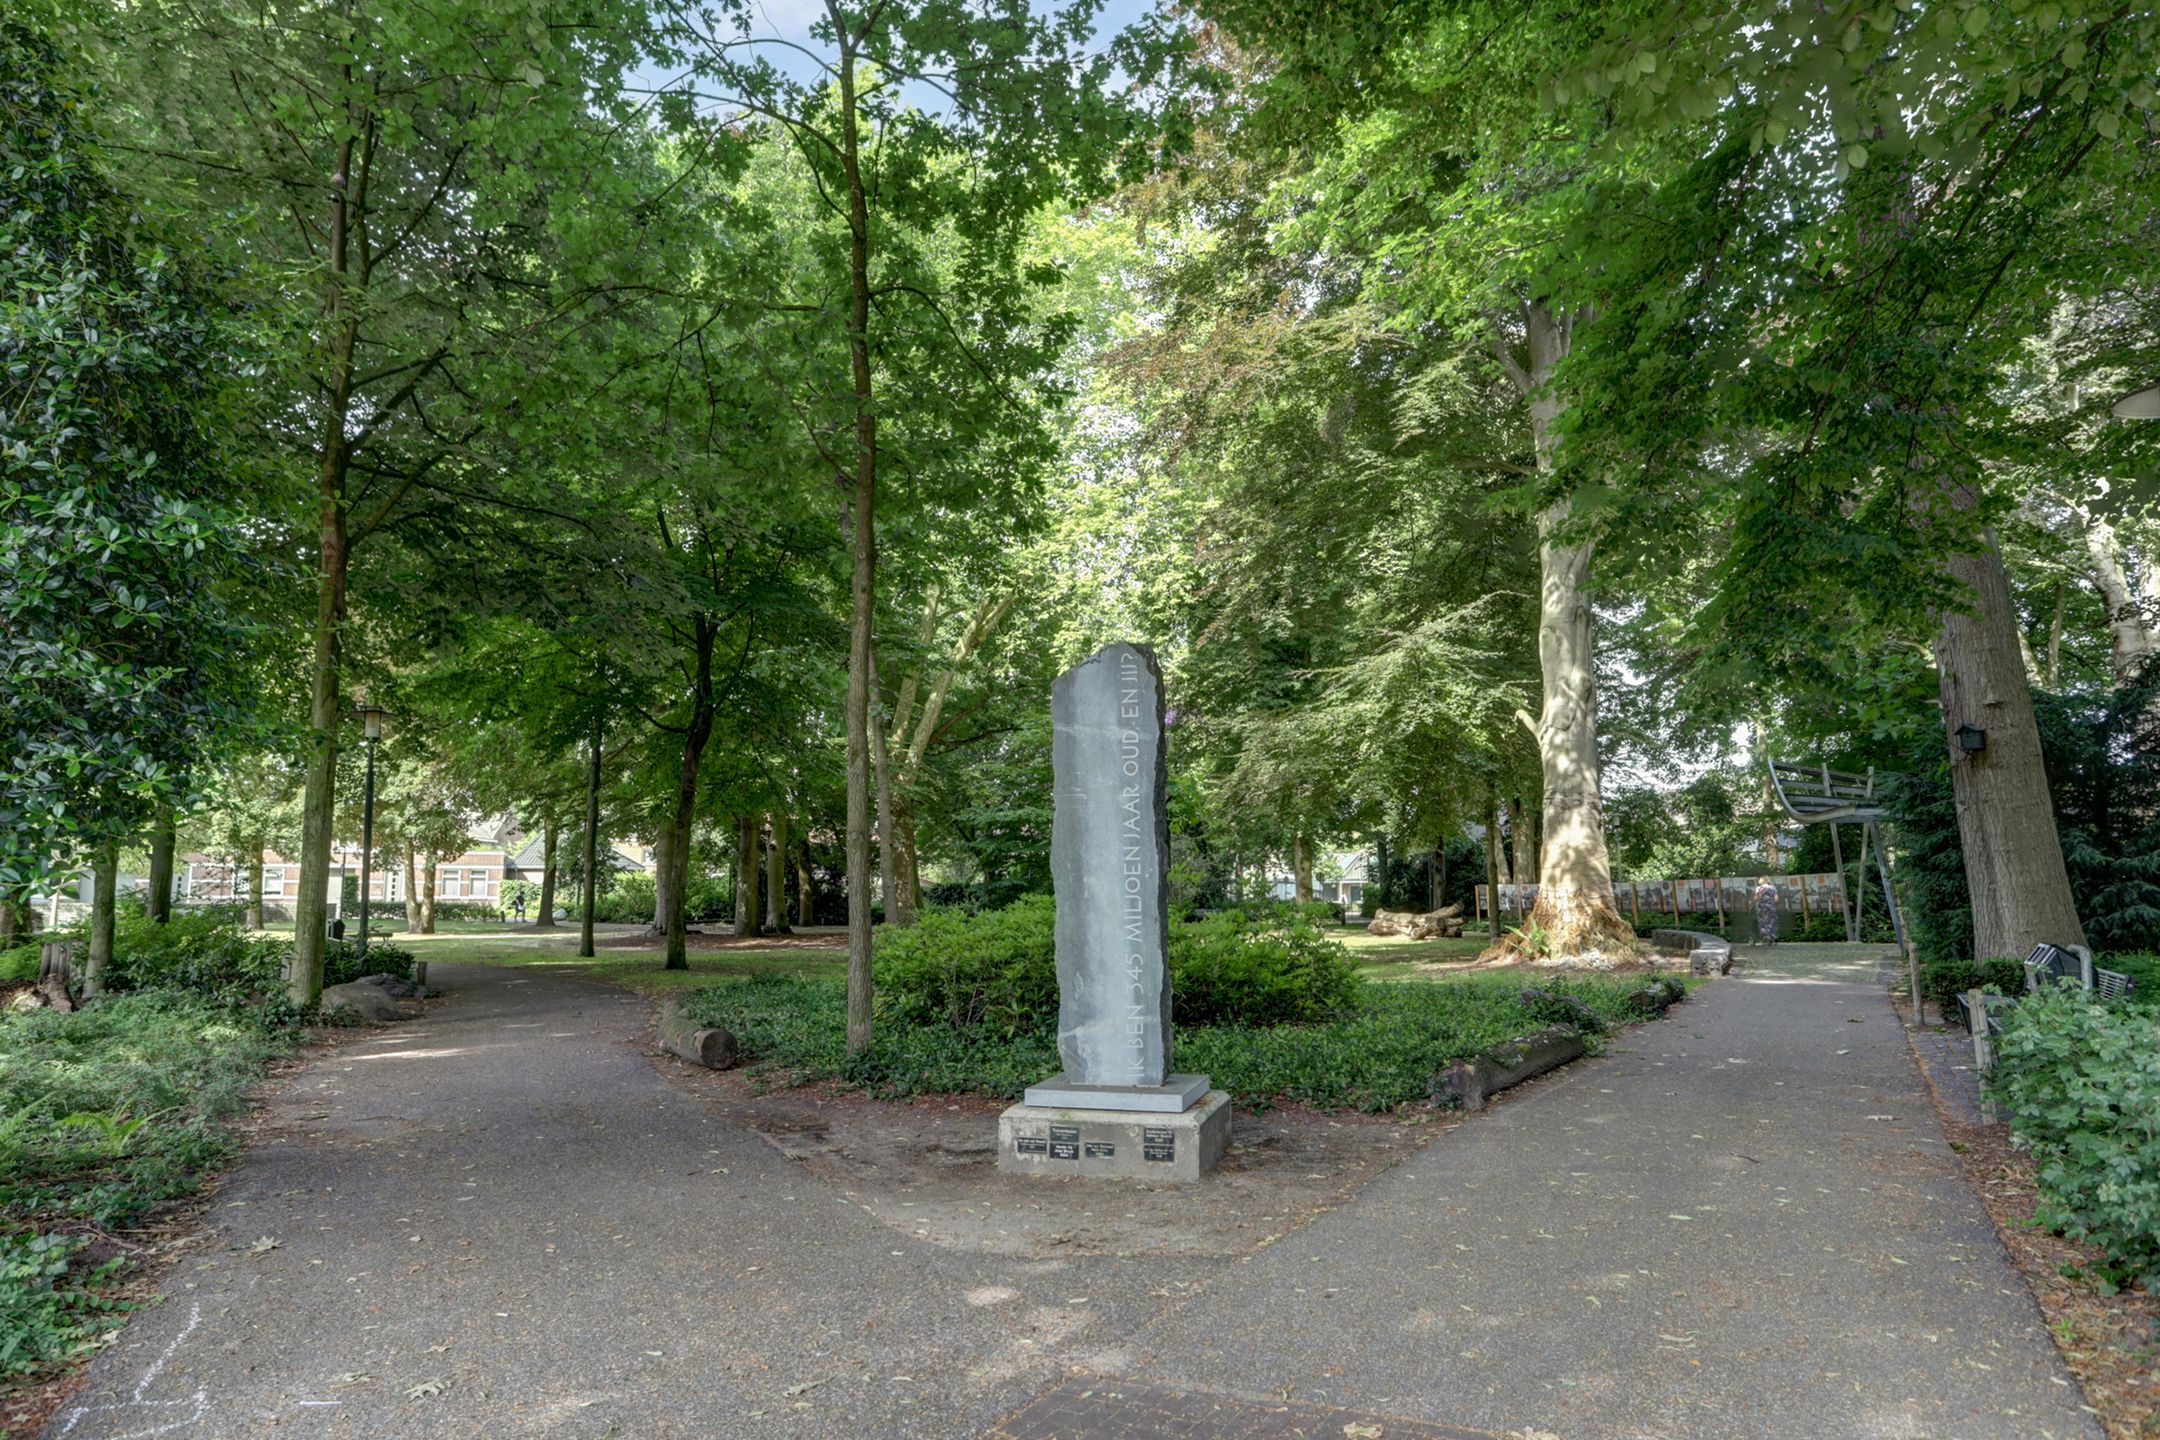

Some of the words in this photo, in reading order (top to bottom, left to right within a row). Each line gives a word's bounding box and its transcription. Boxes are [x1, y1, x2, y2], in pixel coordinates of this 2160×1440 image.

[1120, 653, 1138, 682] JIJ?
[1121, 689, 1139, 717] EN
[1123, 784, 1140, 838] JAAR
[1123, 846, 1142, 942] MILJOEN
[1125, 953, 1143, 994] 345
[1126, 1005, 1143, 1048] BEN
[1128, 1057, 1145, 1077] IK
